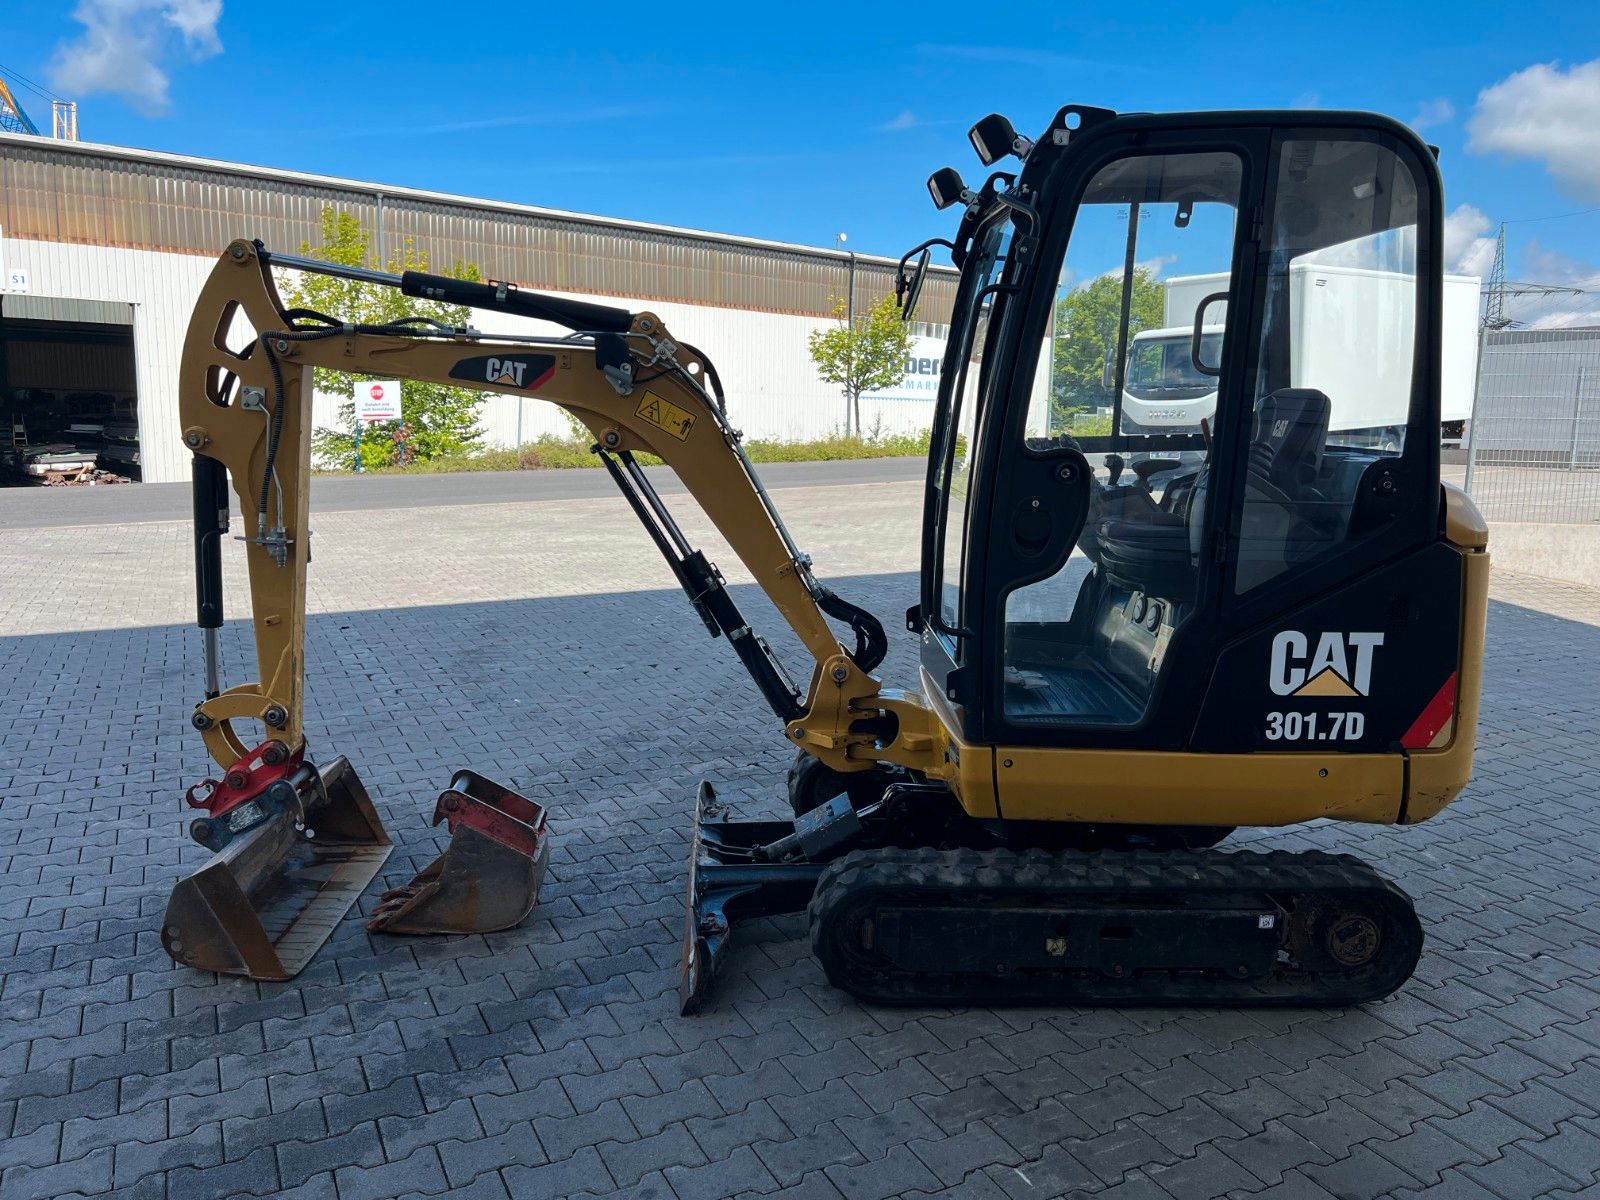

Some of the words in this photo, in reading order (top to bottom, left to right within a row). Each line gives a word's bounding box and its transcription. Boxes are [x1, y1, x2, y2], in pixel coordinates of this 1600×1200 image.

[12, 274, 25, 284] S1
[485, 357, 527, 386] CAT
[371, 389, 384, 397] STOP
[1272, 419, 1289, 437] CAT
[1269, 630, 1385, 697] CAT
[1265, 711, 1365, 741] 301.7D
